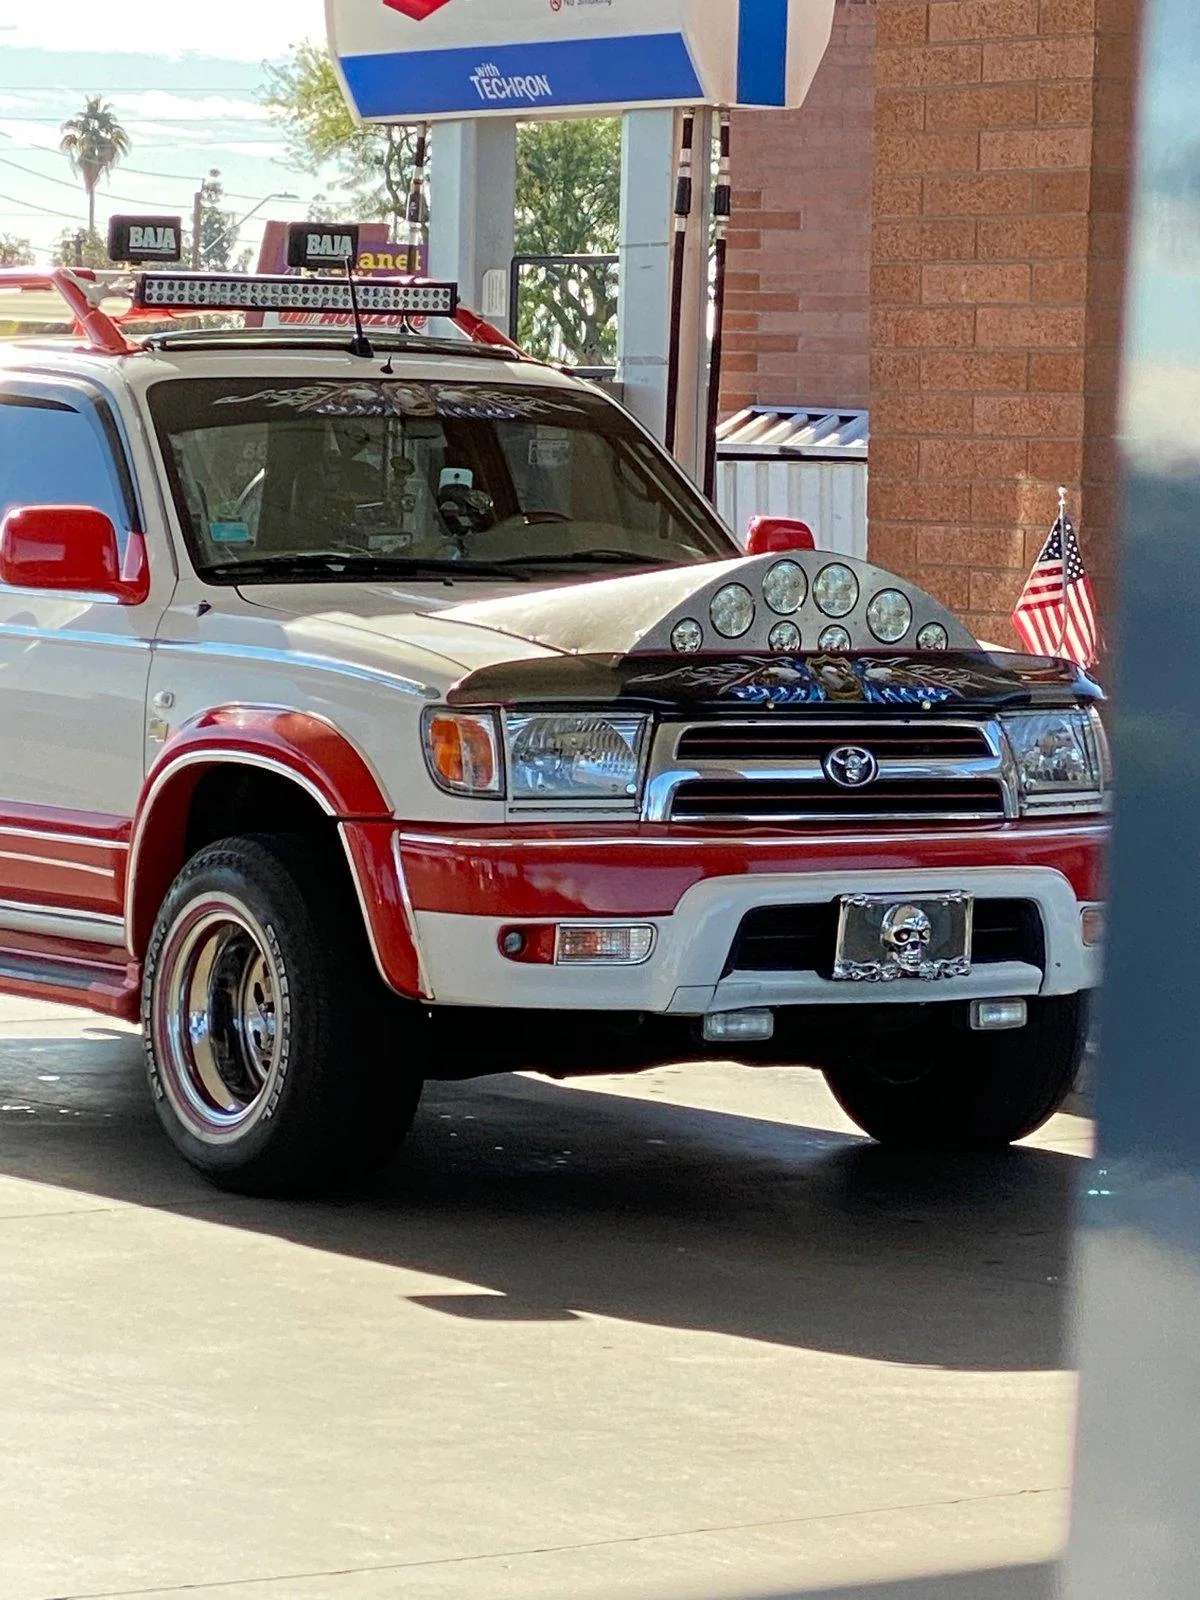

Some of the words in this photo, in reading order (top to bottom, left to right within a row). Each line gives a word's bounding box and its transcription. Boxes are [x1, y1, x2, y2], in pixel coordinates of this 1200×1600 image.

[474, 62, 501, 77] with
[469, 75, 552, 101] TECHRON
[129, 226, 176, 249] BAJA
[306, 234, 353, 255] BAJA
[357, 250, 422, 271] anet
